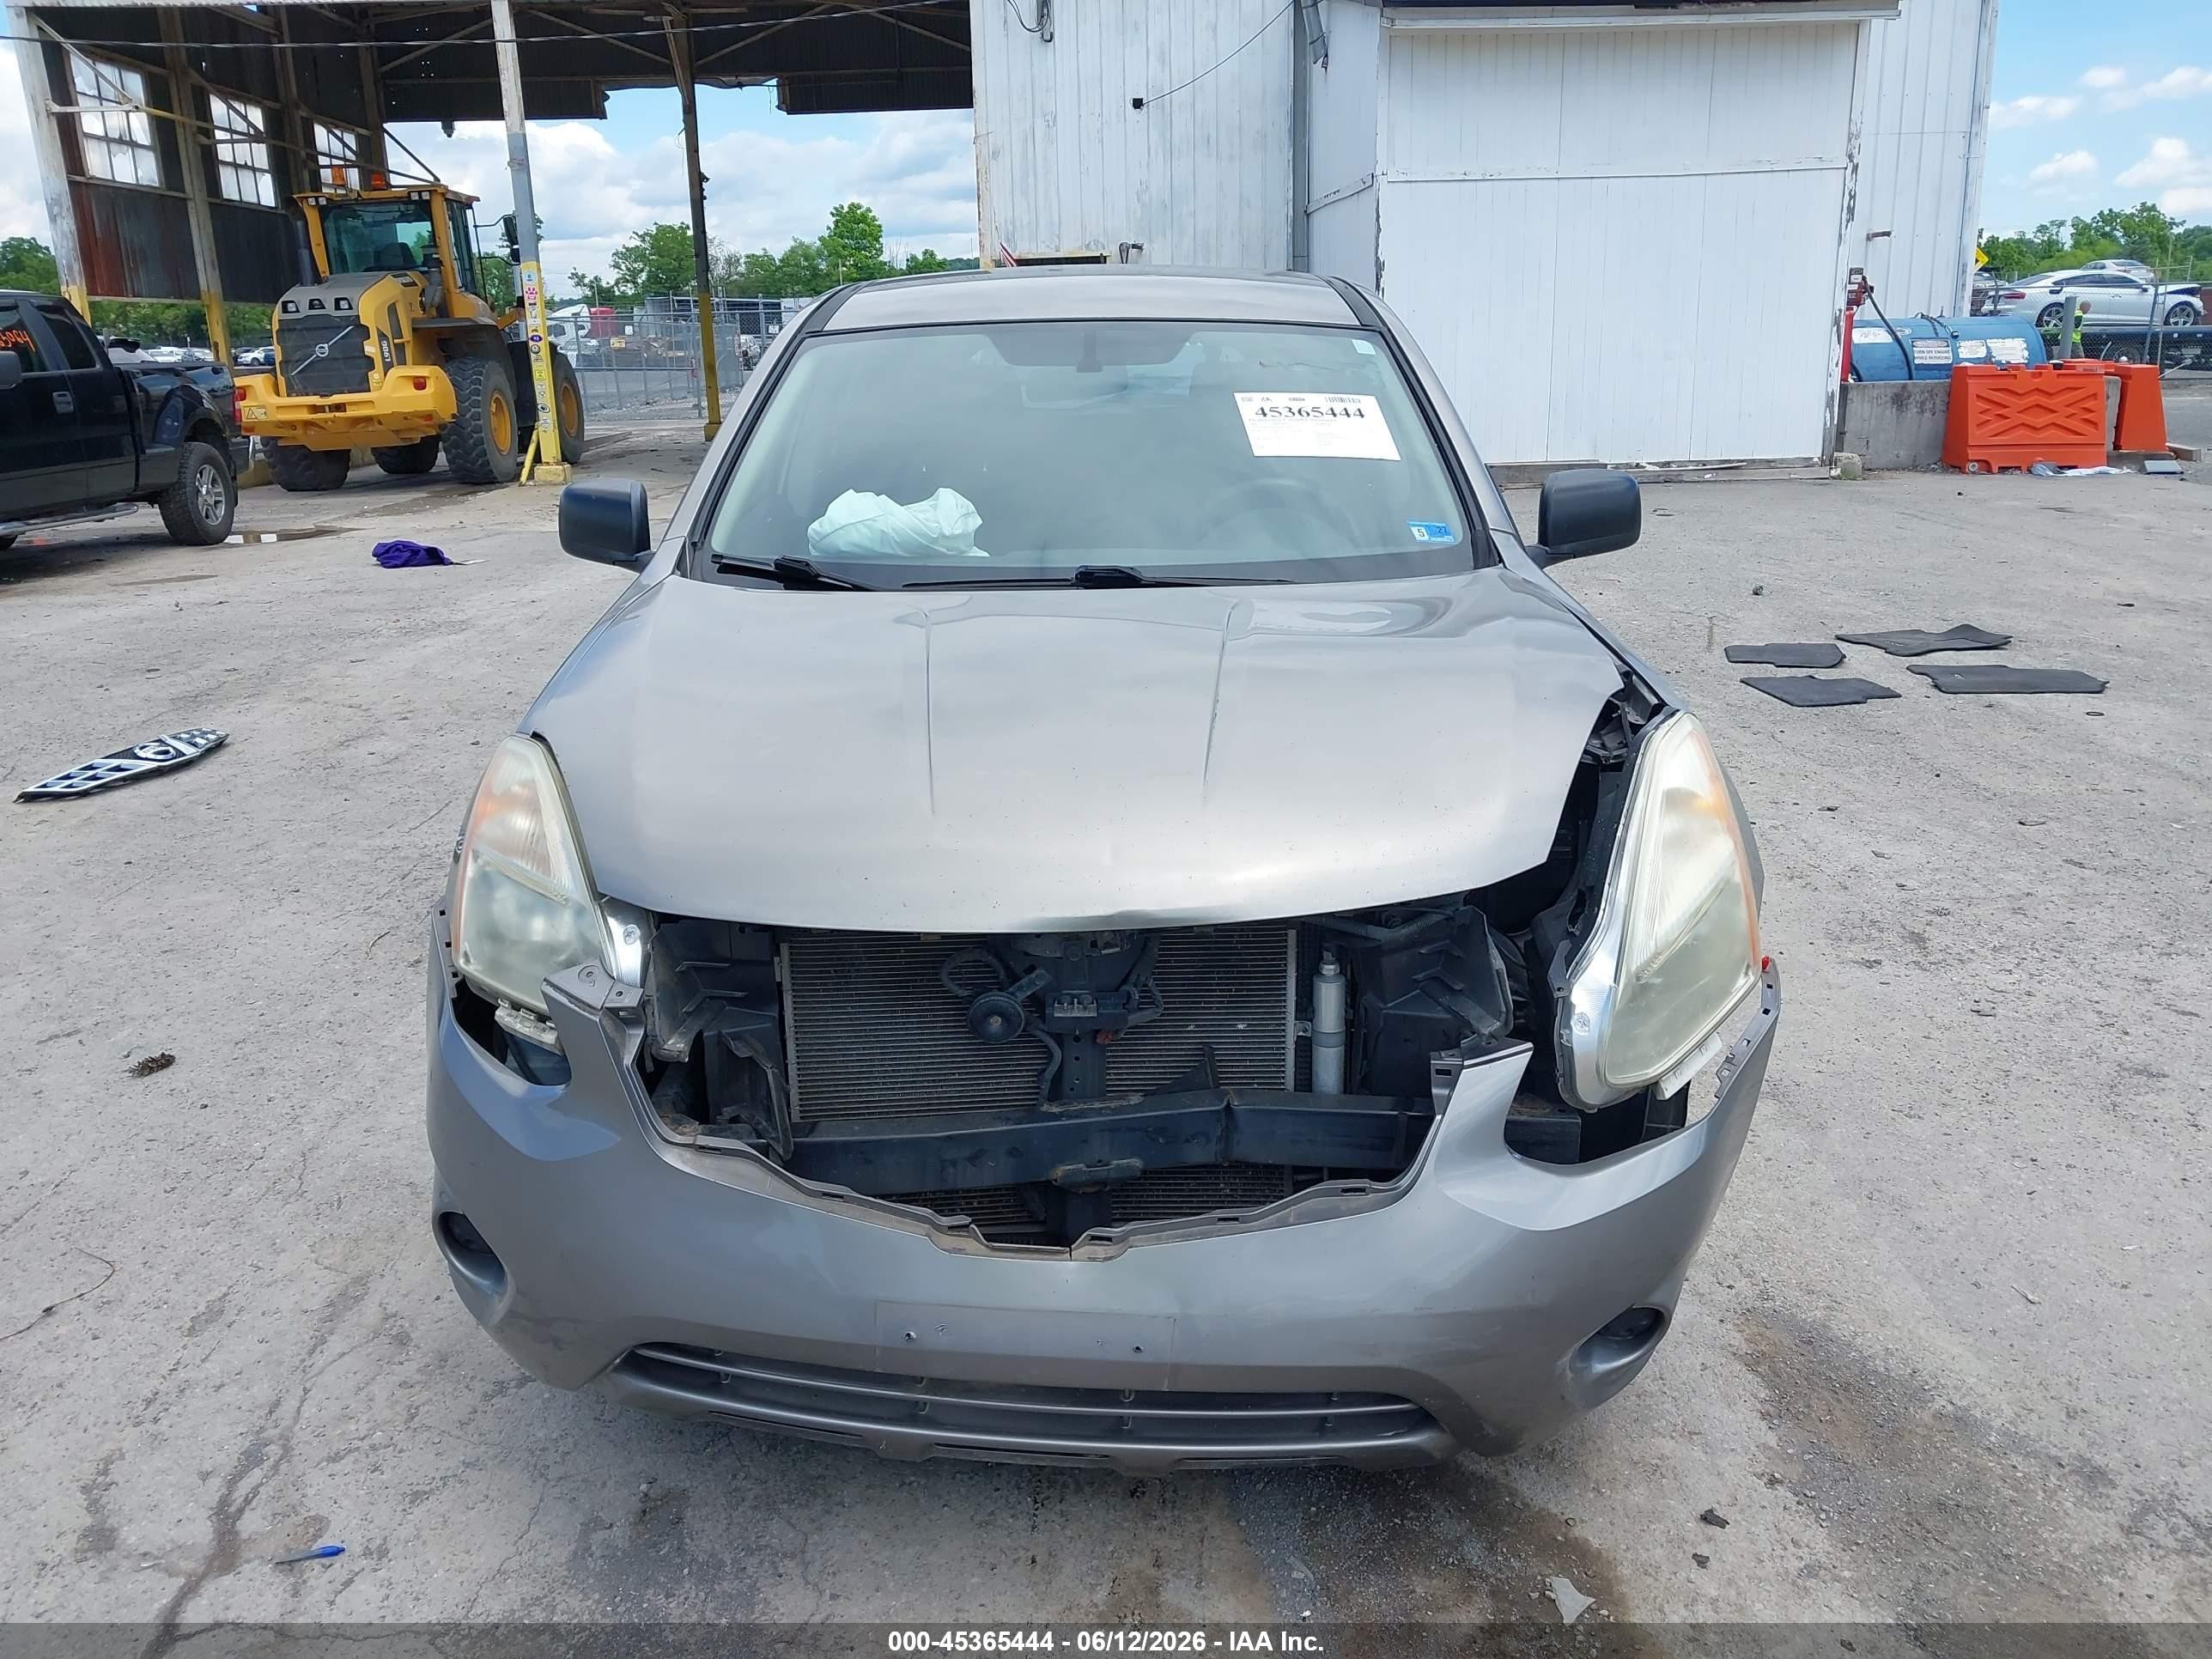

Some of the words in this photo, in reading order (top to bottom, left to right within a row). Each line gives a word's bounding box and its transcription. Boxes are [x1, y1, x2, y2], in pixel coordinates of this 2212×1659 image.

[381, 340, 392, 362] L90G
[1255, 406, 1364, 418] 45365444
[1417, 528, 1425, 538] 5
